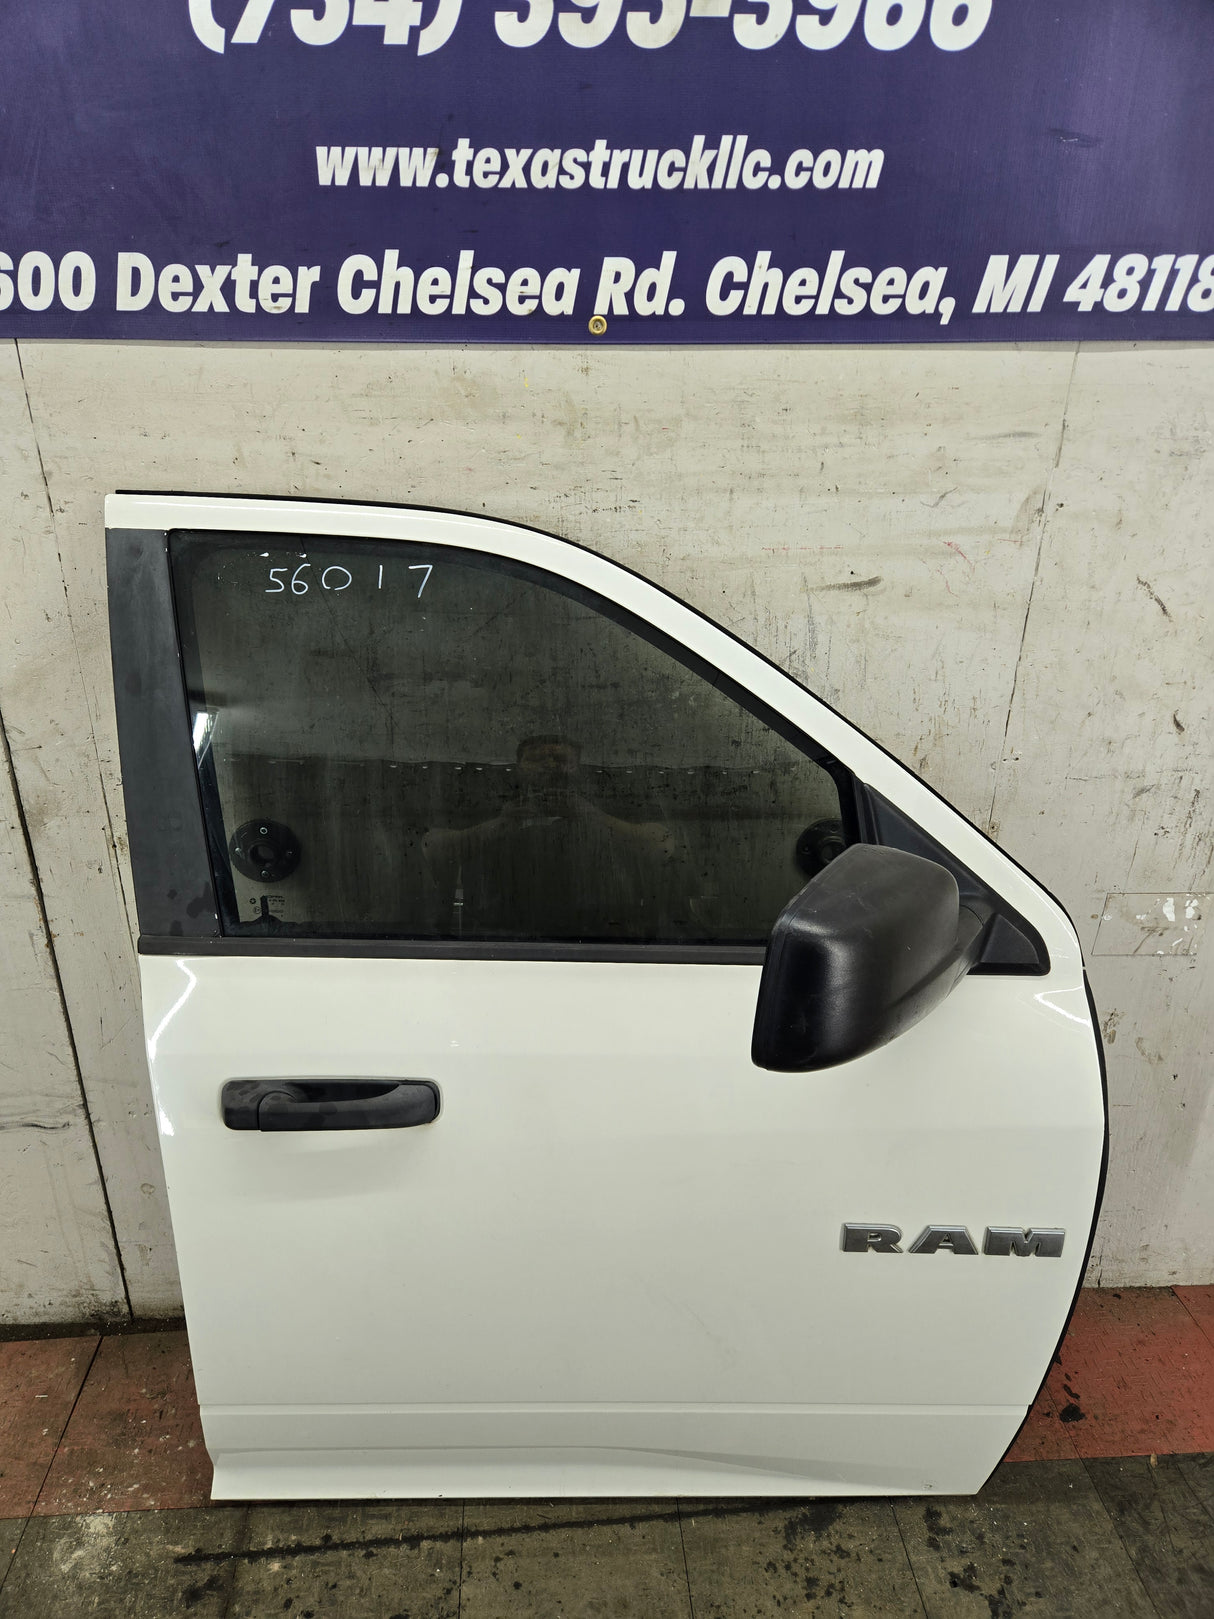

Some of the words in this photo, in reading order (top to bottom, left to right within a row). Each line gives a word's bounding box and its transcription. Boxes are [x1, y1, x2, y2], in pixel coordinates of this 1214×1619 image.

[316, 135, 884, 190] www.texastruckllc.com
[116, 251, 320, 315] Dexter
[337, 250, 580, 316] Chelsea
[594, 251, 685, 316] Rd.
[706, 250, 955, 325] Chelsea,
[972, 254, 1060, 313] MI
[1063, 252, 1214, 312] 48118
[265, 563, 433, 598] 56017
[841, 1222, 1066, 1258] RAM
